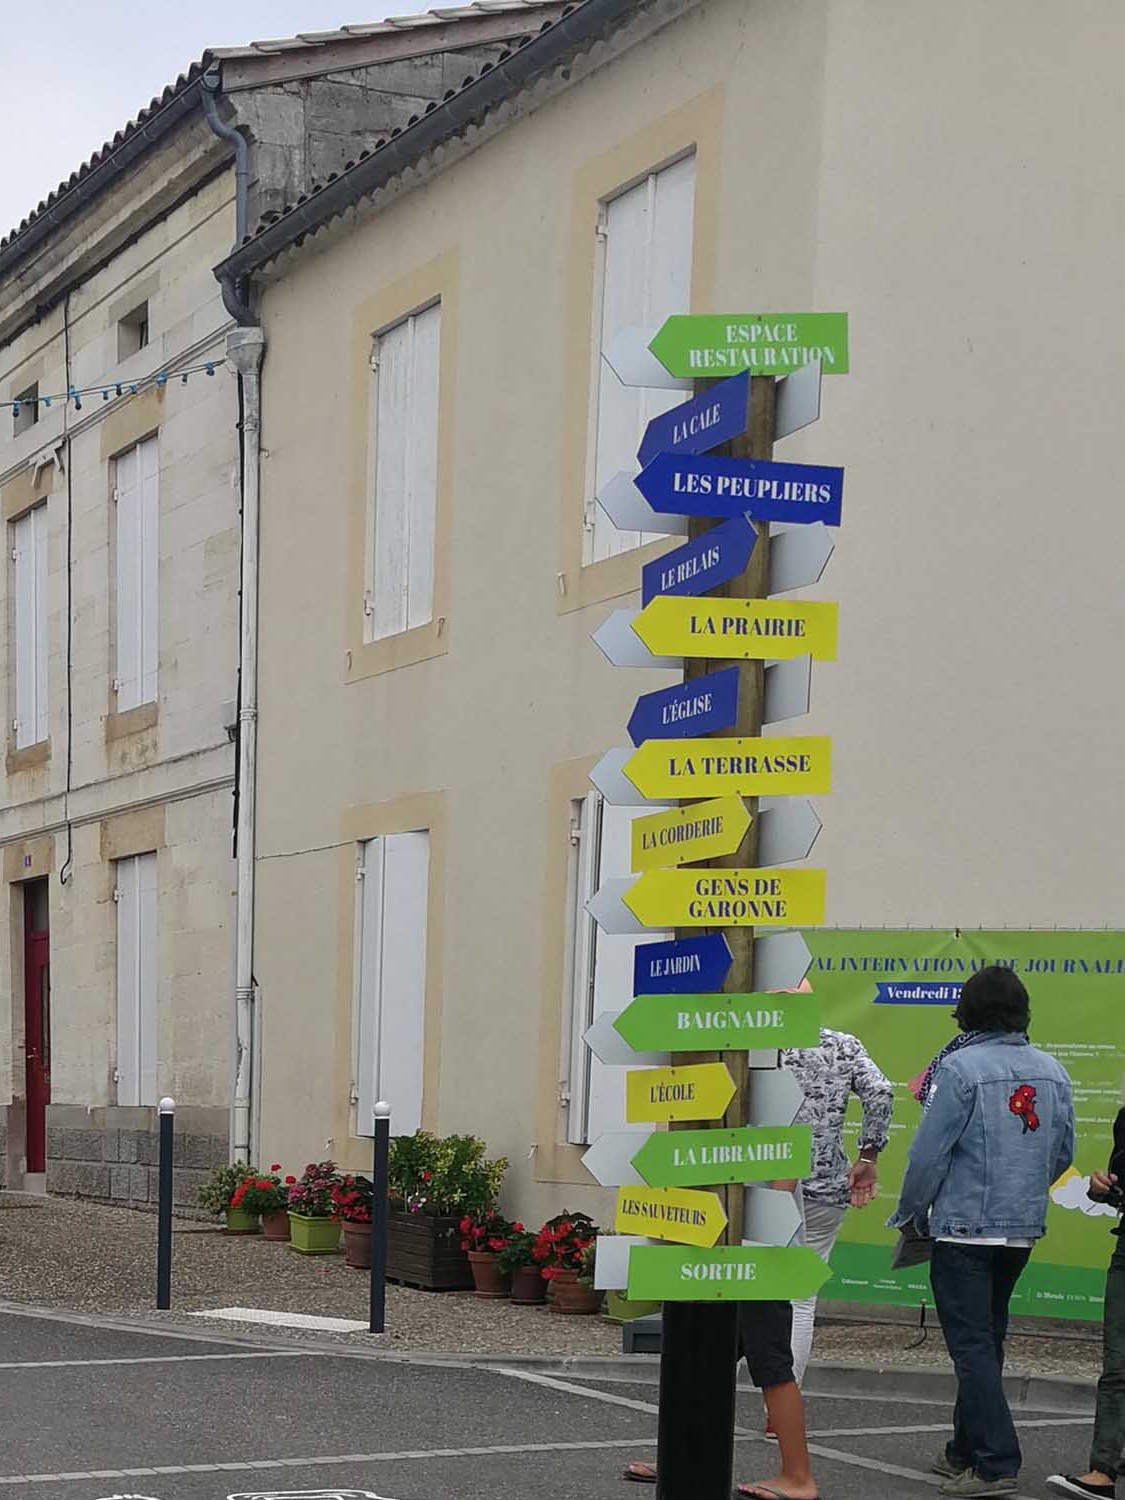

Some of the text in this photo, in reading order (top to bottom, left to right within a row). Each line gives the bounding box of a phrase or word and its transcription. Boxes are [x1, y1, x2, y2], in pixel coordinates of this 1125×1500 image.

[725, 323, 798, 344] ESPACE
[689, 345, 836, 368] RESTAURATION
[672, 403, 721, 445] LA CALE
[673, 472, 831, 503] LES PEUPLIERS
[661, 546, 720, 591] LE RELAIS
[690, 615, 806, 637] LA PRAIRIE
[662, 692, 712, 725] L'ÉGLISE
[668, 754, 811, 776] LA TERRASSE
[642, 815, 723, 850] LA CORDERIE
[695, 878, 782, 897] GENS DE
[688, 899, 788, 919] GARONNE
[650, 954, 701, 977] LE JARDIN
[840, 957, 986, 973] INTERNATIONAL
[1024, 958, 1125, 974] JOURNALI
[887, 986, 948, 1000] Vendredi
[677, 1010, 784, 1030] BAIGNADE
[650, 1081, 695, 1103] L'ÉCOLE
[674, 1142, 793, 1166] LA LIBRAIRIE
[622, 1199, 707, 1226] LES SAUVETEURS
[681, 1263, 756, 1281] SORTIE
